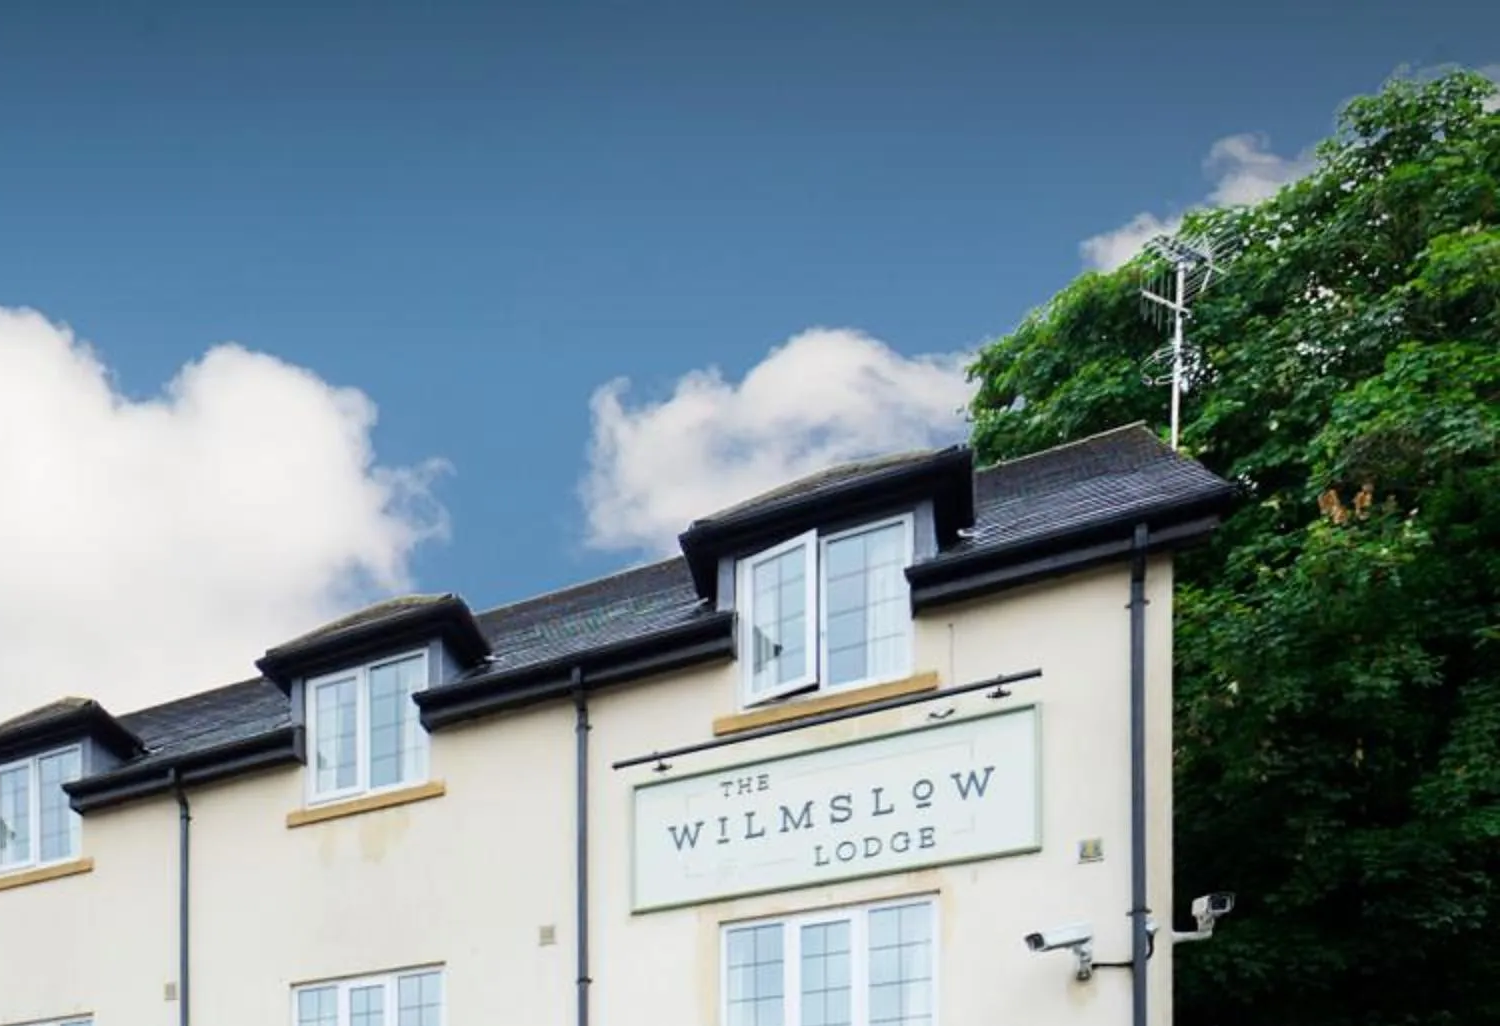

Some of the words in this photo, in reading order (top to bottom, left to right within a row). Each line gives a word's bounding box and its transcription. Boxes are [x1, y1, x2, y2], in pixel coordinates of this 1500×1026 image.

[719, 773, 769, 798] THE
[667, 766, 996, 852] WILMSLOW
[813, 826, 937, 867] LODGE
